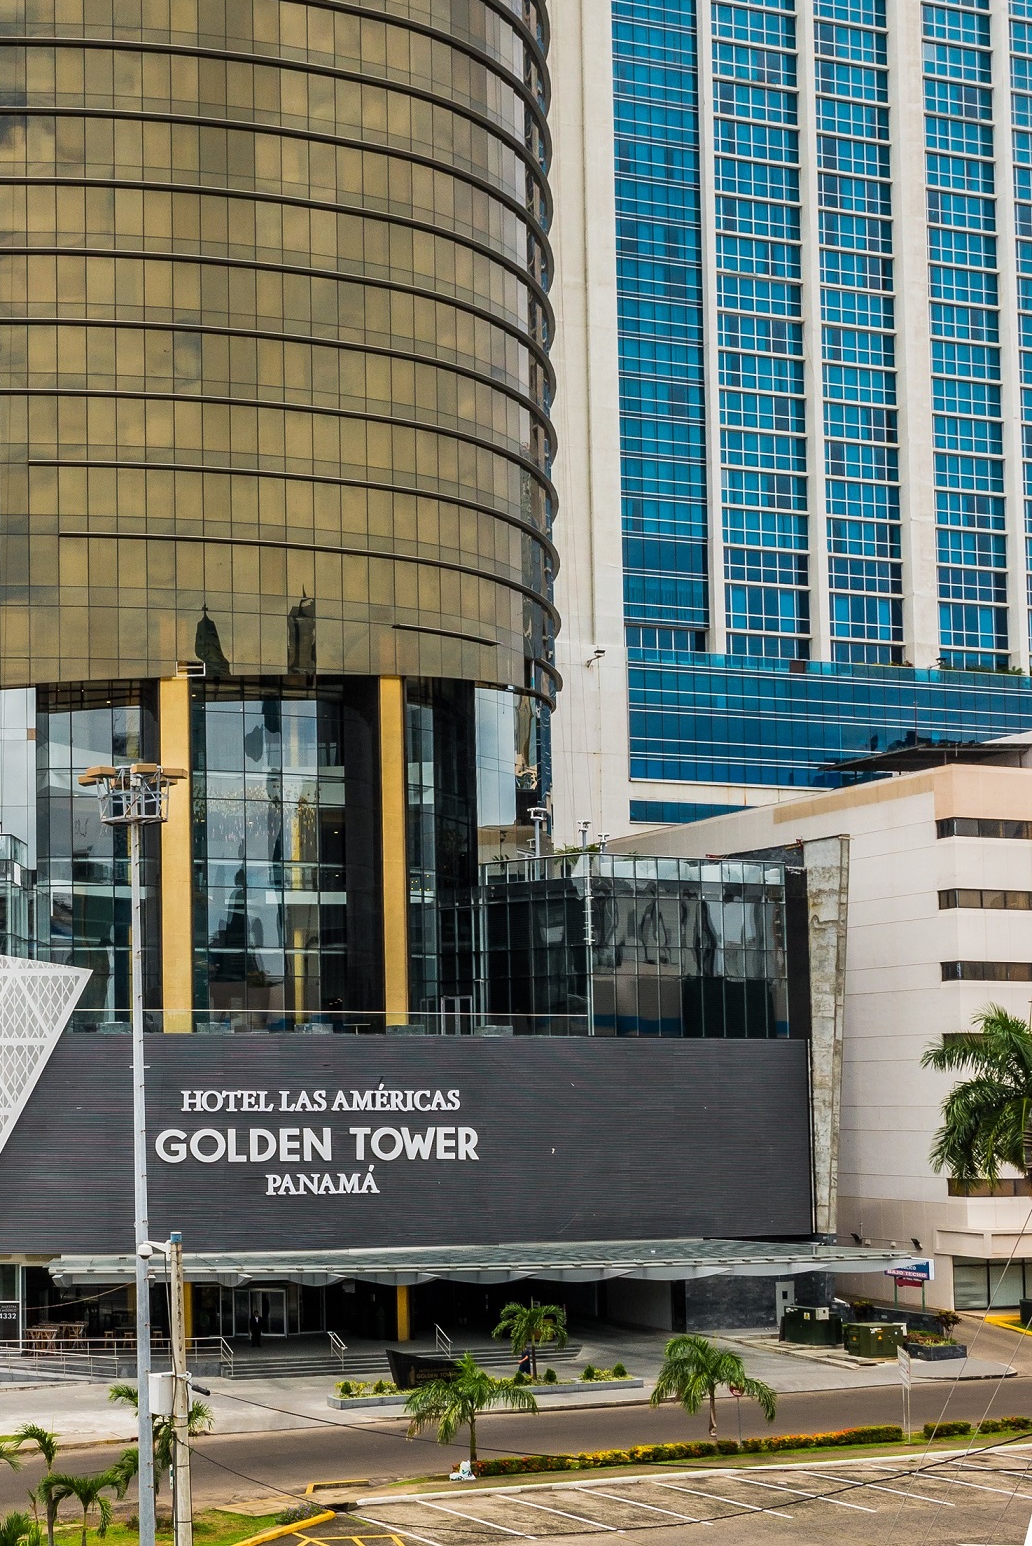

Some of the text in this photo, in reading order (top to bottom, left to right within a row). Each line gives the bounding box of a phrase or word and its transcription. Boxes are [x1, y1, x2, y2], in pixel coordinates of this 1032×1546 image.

[180, 1083, 461, 1113] HOTEL LAS AMÉRICAS
[154, 1127, 480, 1163] GOLDEN TOWER
[265, 1165, 380, 1195] PANAMÁ
